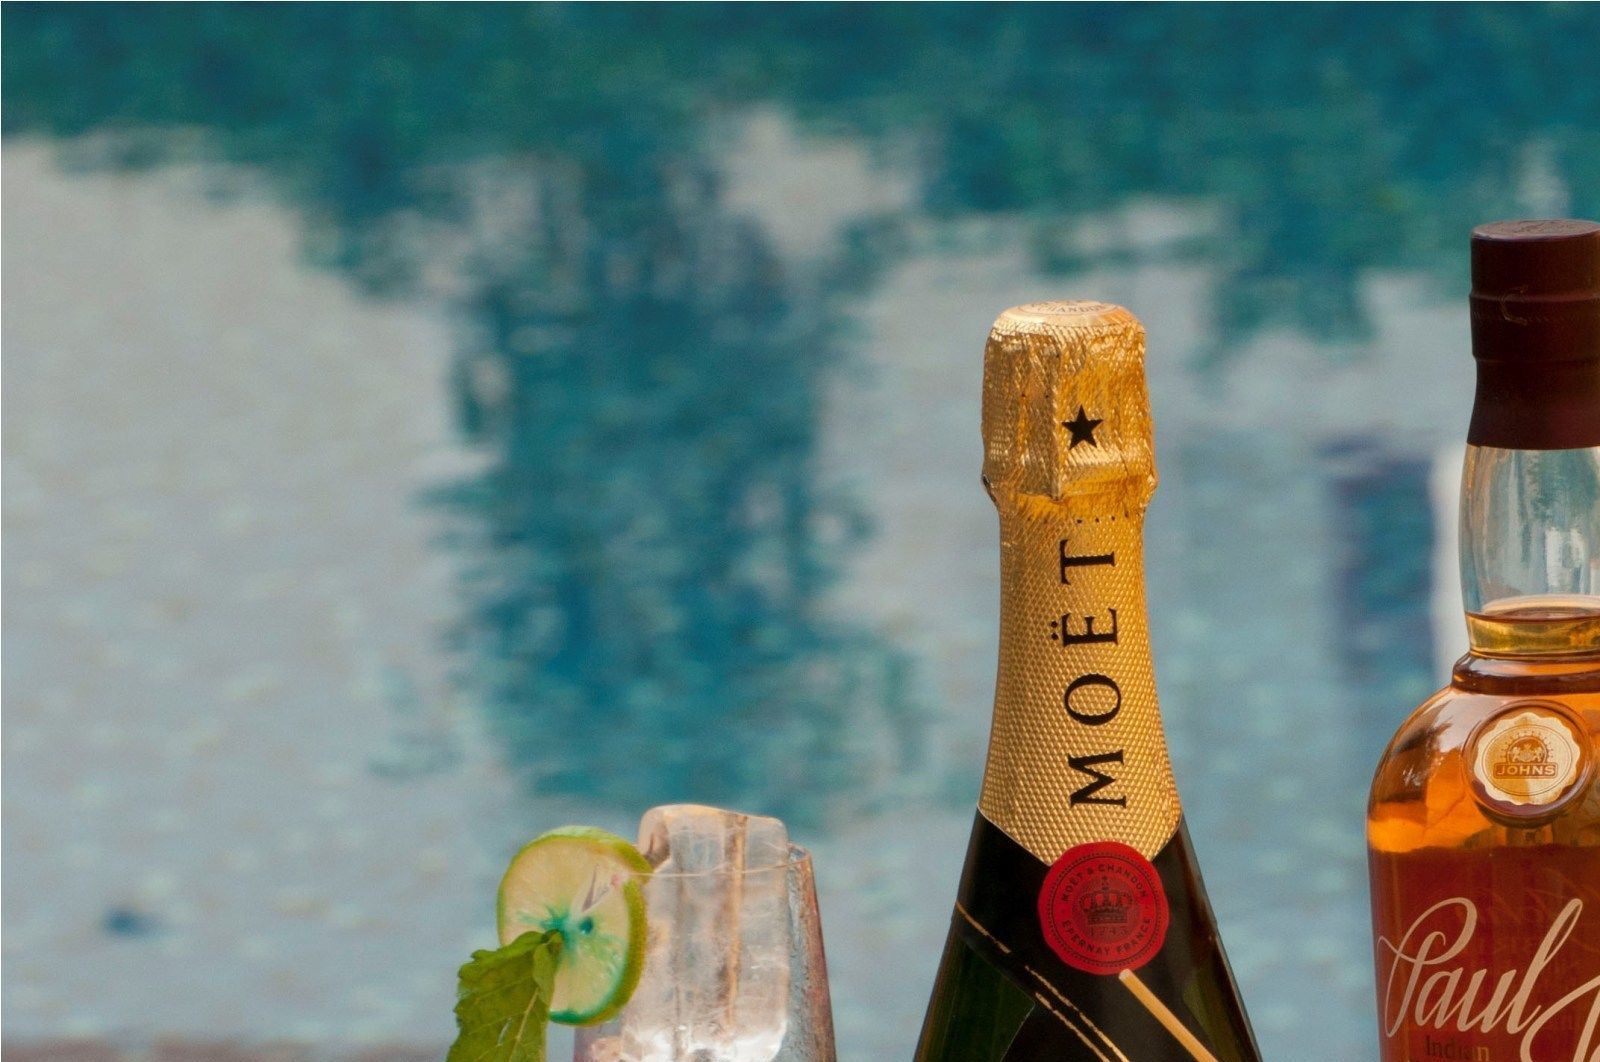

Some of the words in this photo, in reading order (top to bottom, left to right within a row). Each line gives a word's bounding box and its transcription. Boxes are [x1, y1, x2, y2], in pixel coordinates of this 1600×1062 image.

[1050, 539, 1127, 808] MOËT
[1496, 765, 1556, 776] JOHNS
[1098, 864, 1149, 898] CHANDON
[1116, 918, 1152, 953] FRANCE
[1377, 897, 1583, 1038] Paul
